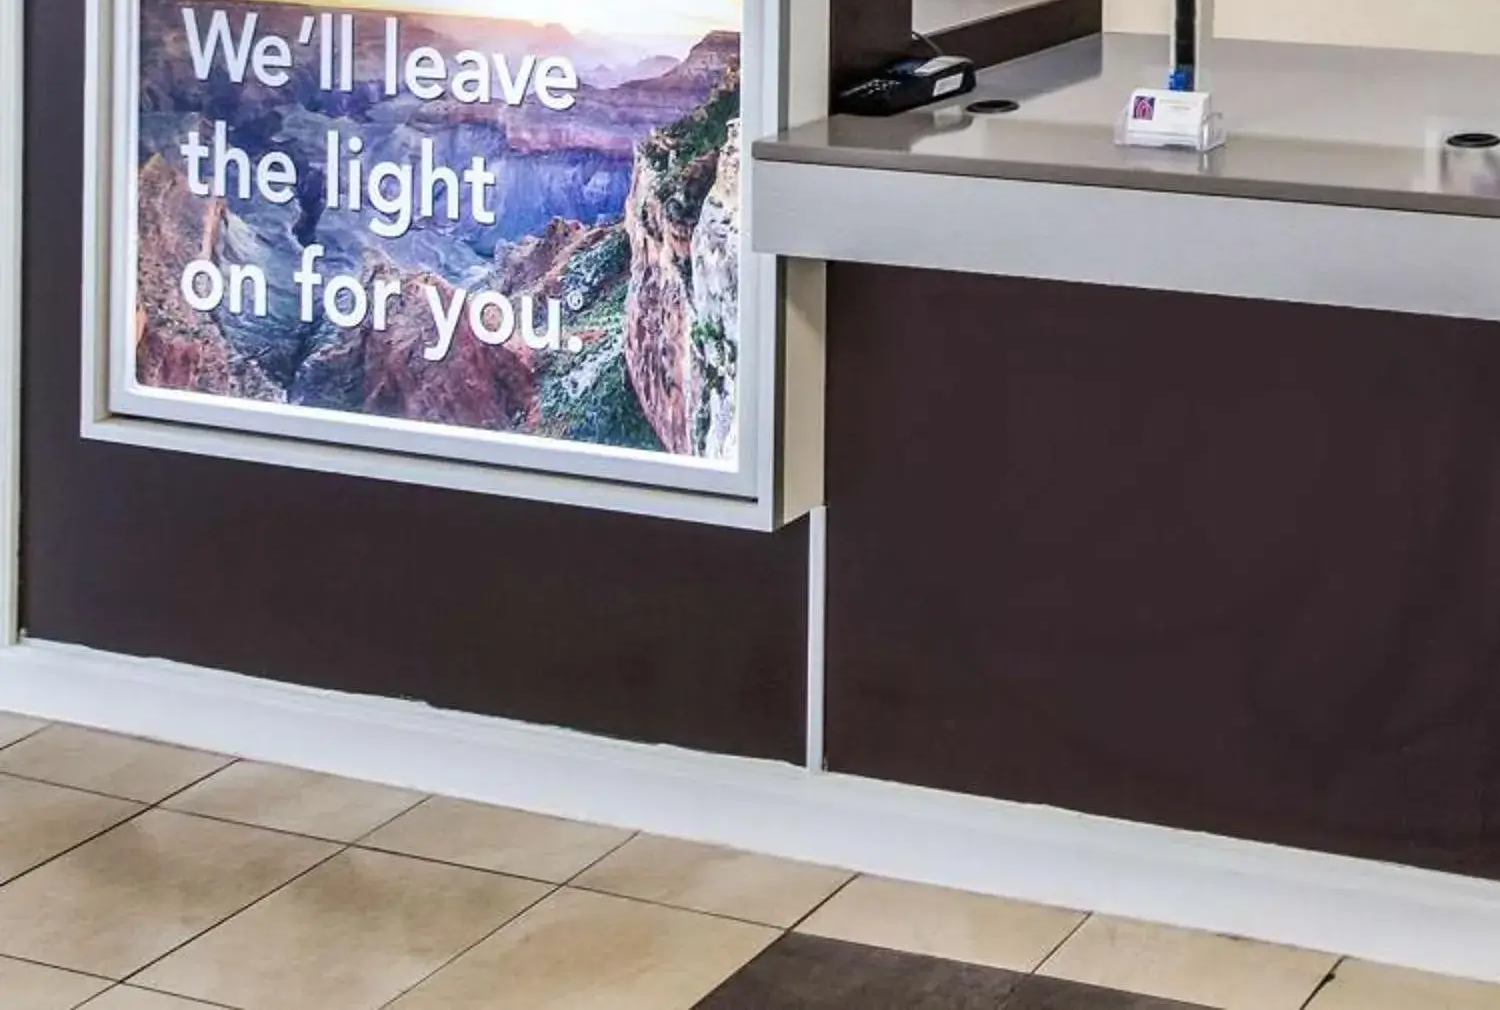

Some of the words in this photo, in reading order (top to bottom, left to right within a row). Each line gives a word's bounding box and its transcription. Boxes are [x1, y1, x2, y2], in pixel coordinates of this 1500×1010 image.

[384, 17, 579, 110] leave
[181, 120, 297, 204] the
[326, 130, 496, 238] light
[180, 257, 267, 317] on
[294, 244, 401, 331] for
